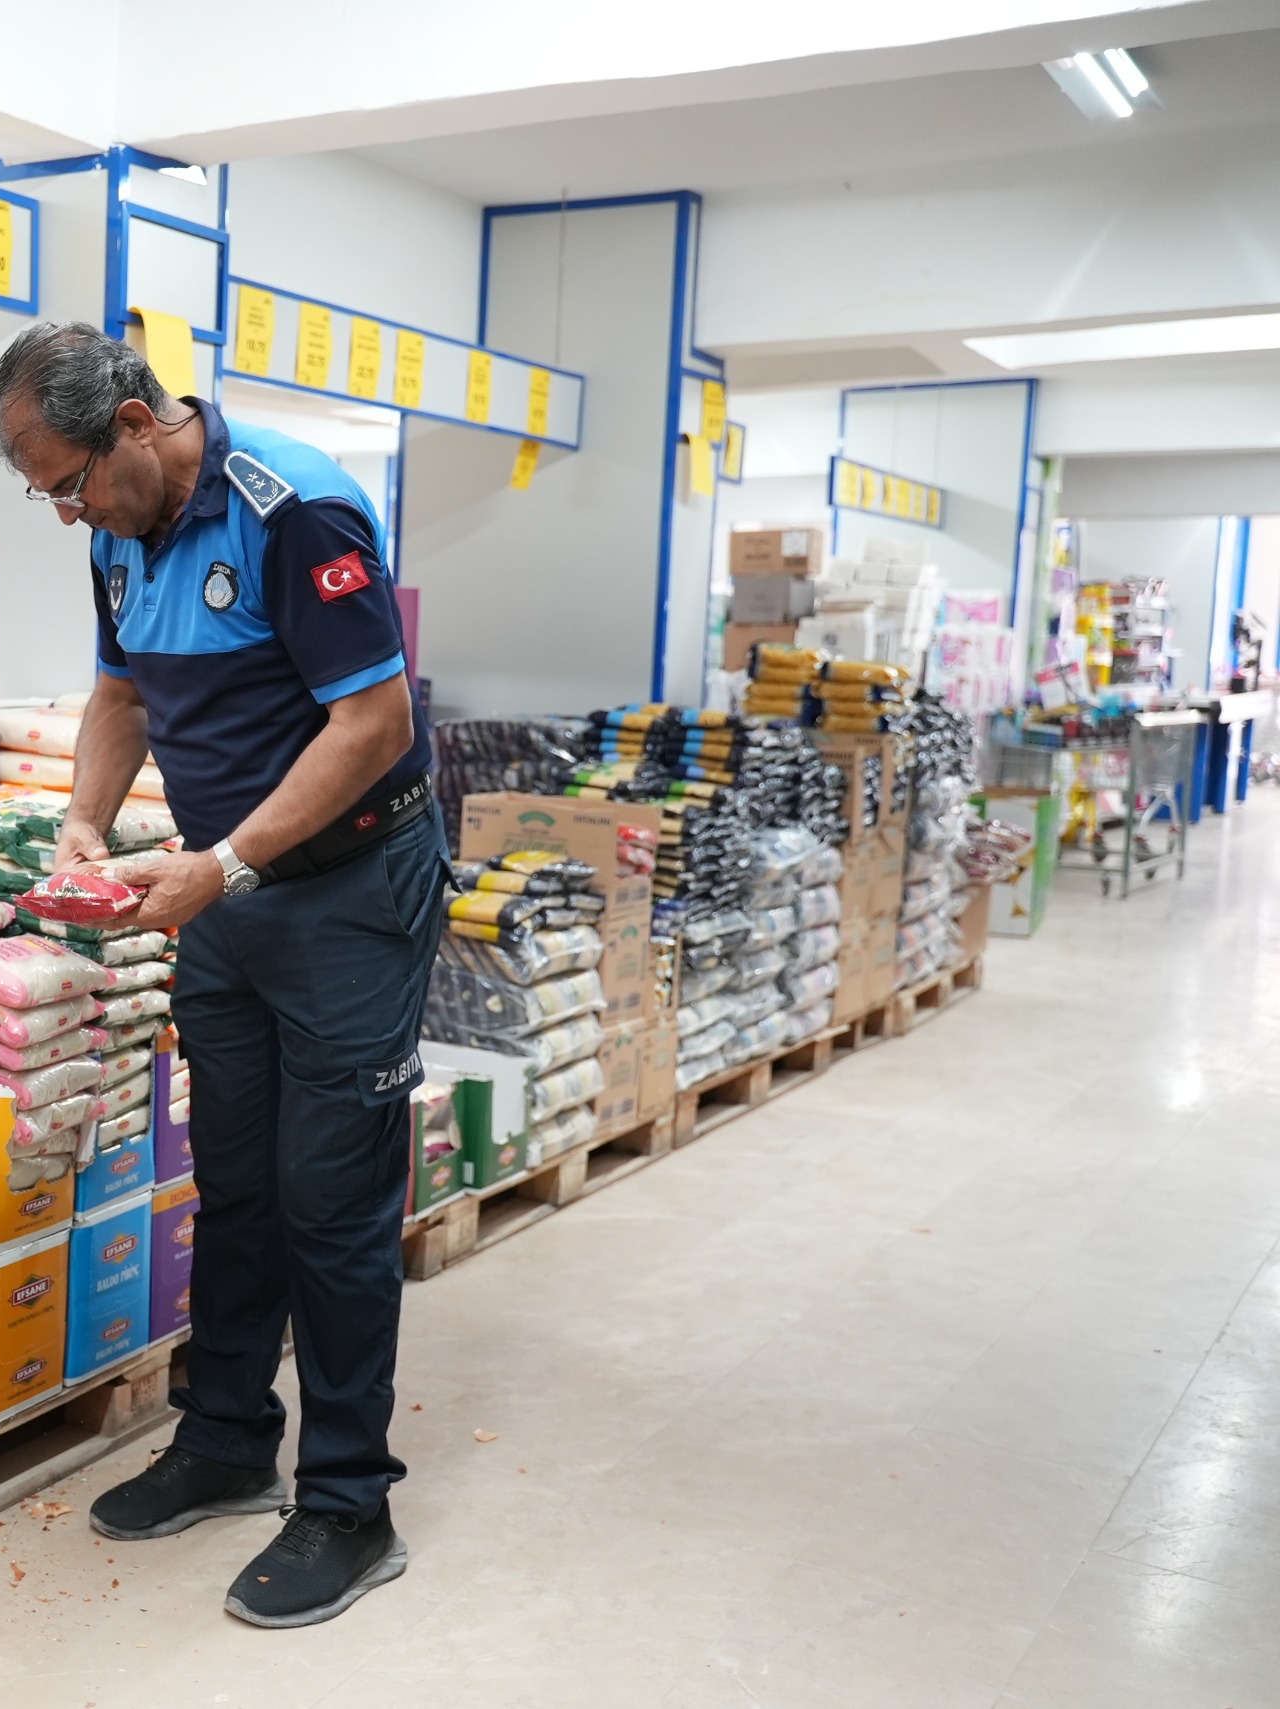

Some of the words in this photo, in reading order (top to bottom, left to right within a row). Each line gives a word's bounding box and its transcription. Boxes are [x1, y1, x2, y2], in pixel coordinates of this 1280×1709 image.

[375, 1052, 421, 1092] ZABITA
[113, 1157, 137, 1170] EFSANE
[26, 1196, 52, 1212] EFSANE
[105, 1238, 135, 1257] EFSANE
[14, 1280, 49, 1304] EFSANE
[96, 1273, 120, 1292] BALDO
[104, 1321, 128, 1337] EFSANE
[15, 1361, 43, 1381] EFSANE
